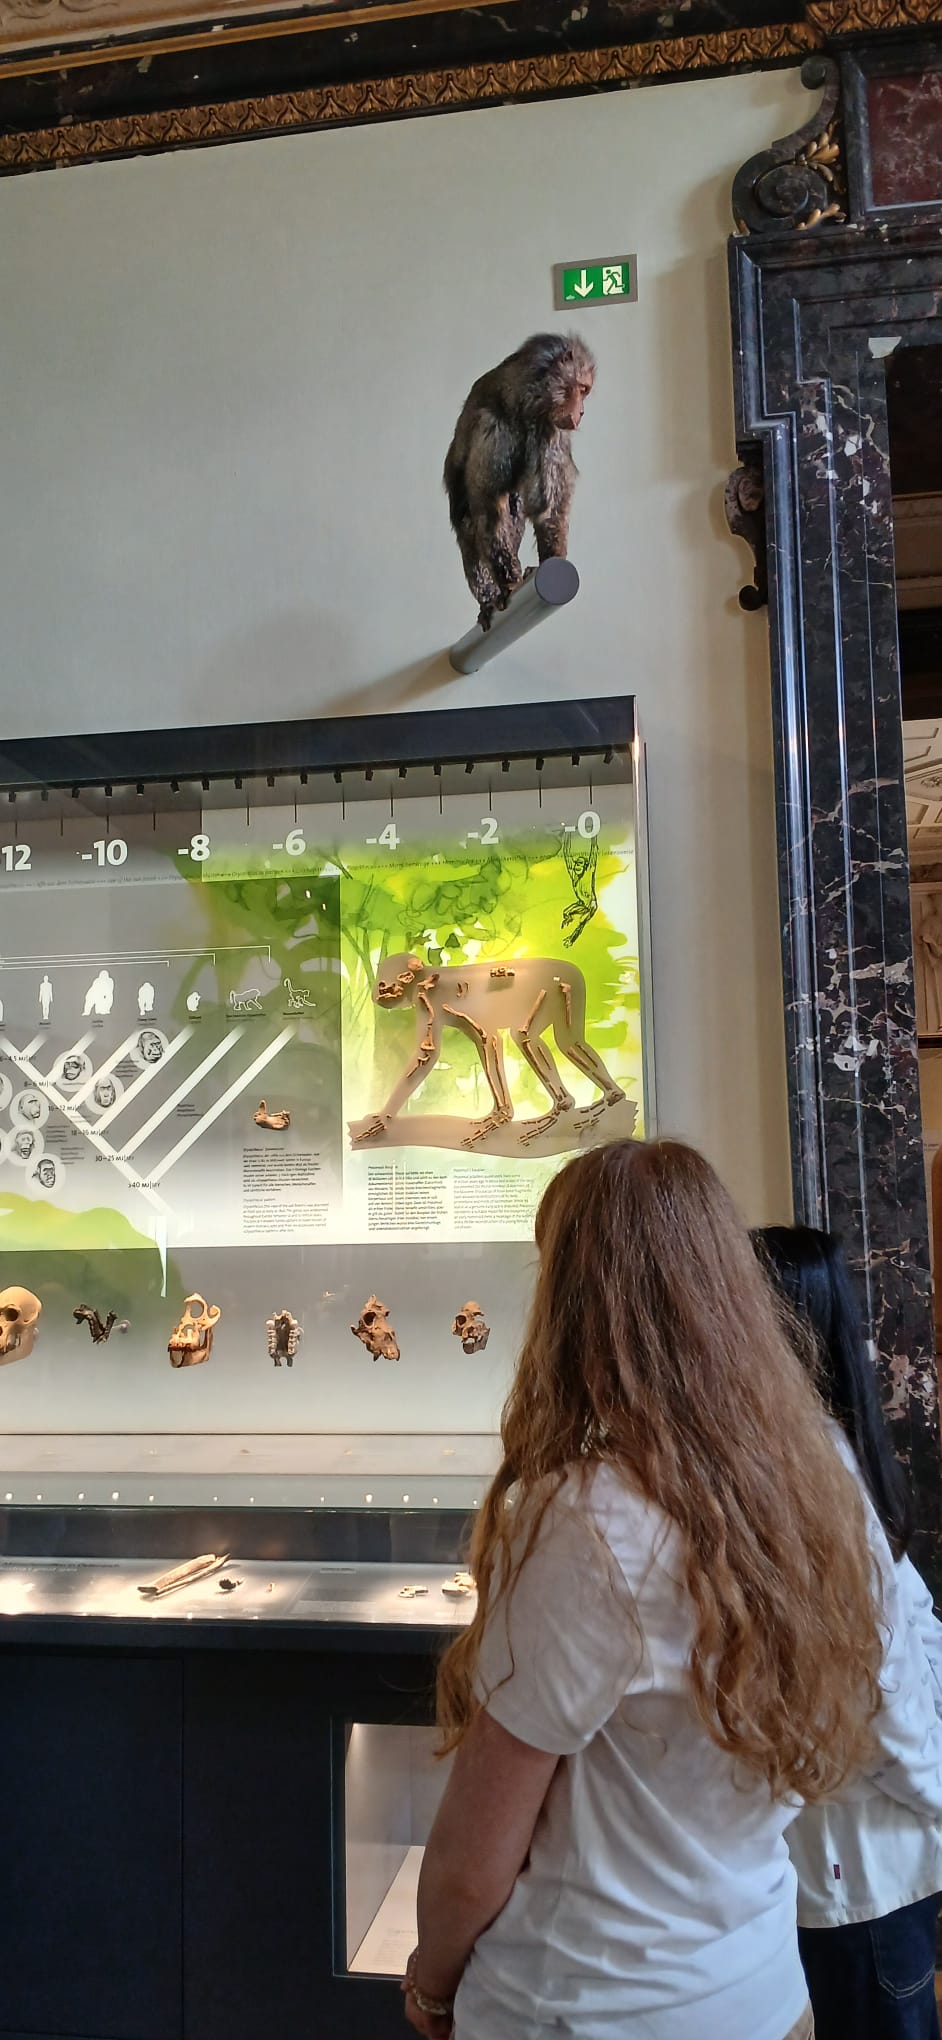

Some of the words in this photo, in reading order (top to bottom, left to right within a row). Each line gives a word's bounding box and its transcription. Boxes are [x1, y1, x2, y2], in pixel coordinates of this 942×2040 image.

[81, 839, 128, 866] -10
[178, 834, 210, 861] -8
[272, 829, 306, 856] -6
[365, 823, 400, 850] -4
[467, 817, 499, 845] -2
[564, 810, 601, 839] -0
